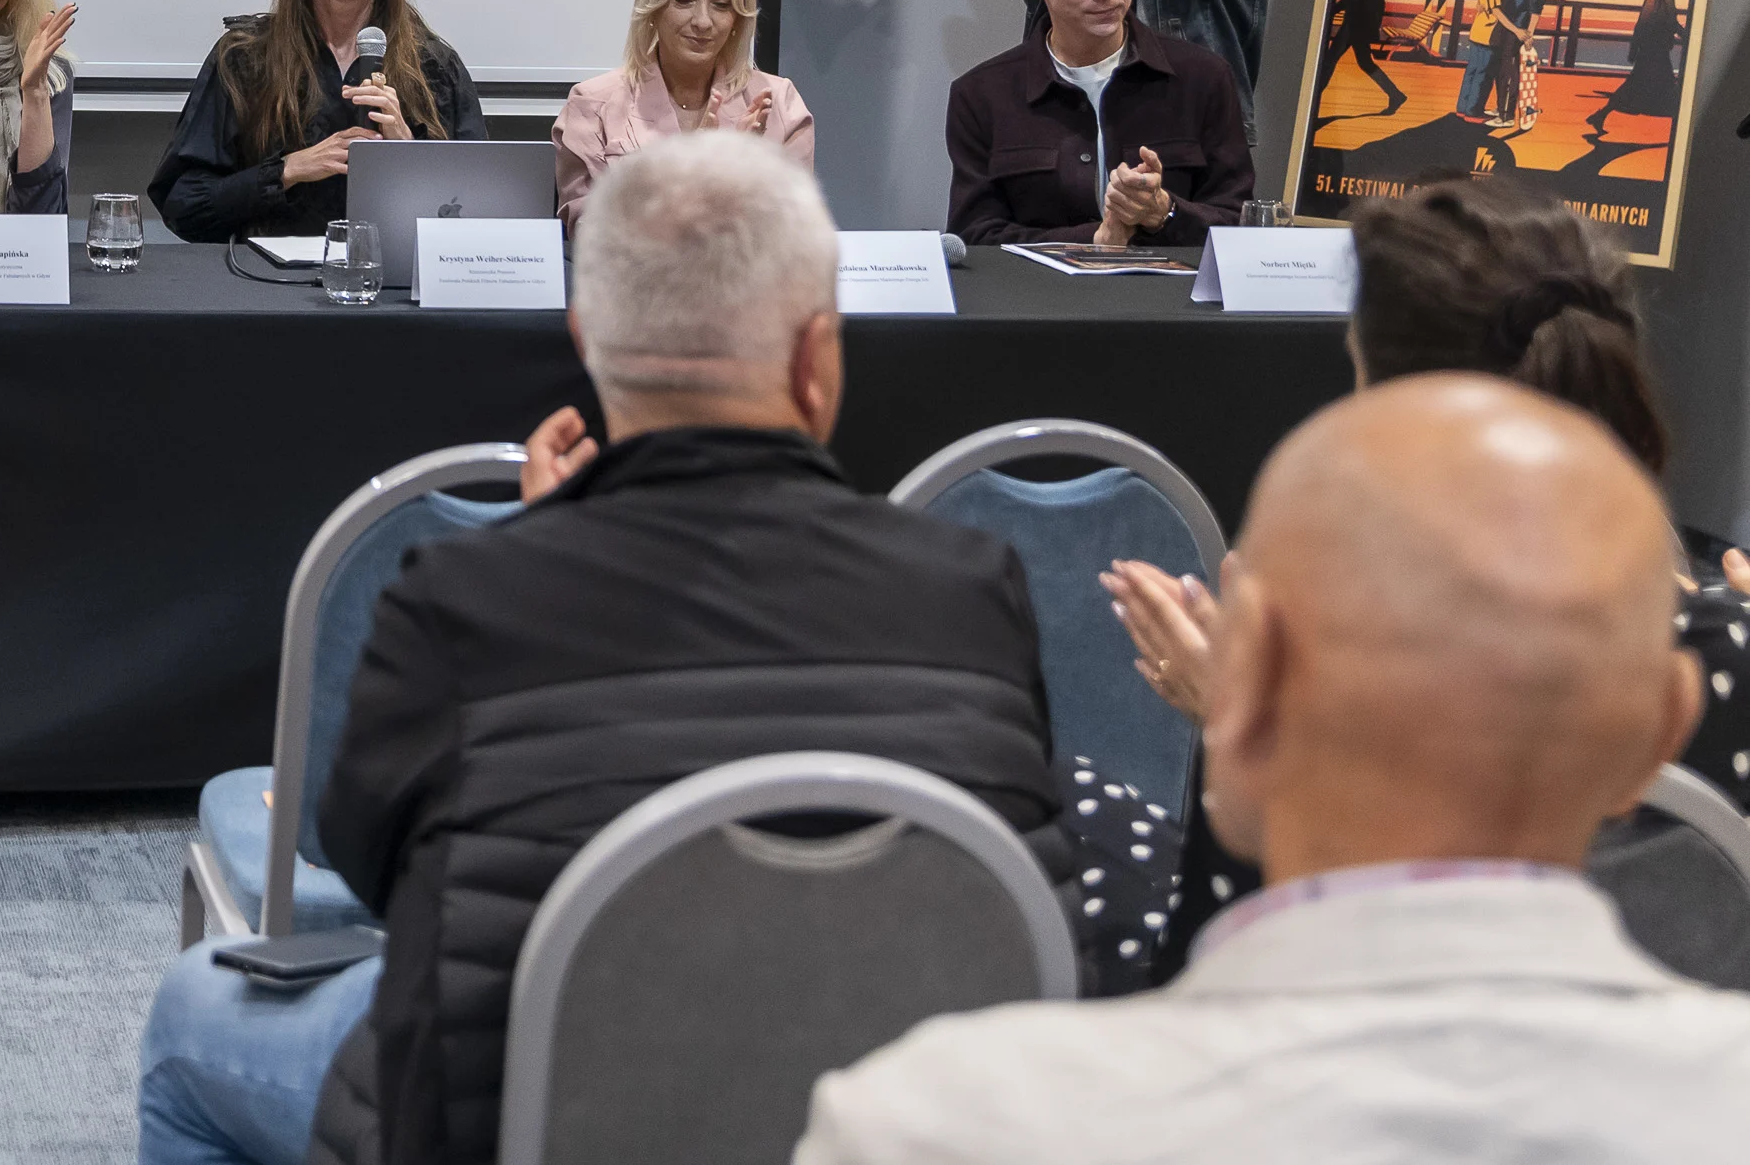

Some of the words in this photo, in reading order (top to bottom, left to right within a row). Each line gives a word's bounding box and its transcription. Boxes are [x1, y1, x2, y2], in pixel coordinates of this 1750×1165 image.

[1315, 174, 1335, 194] 51.
[438, 255, 474, 264] Krystyna
[1260, 260, 1290, 268] Norbert
